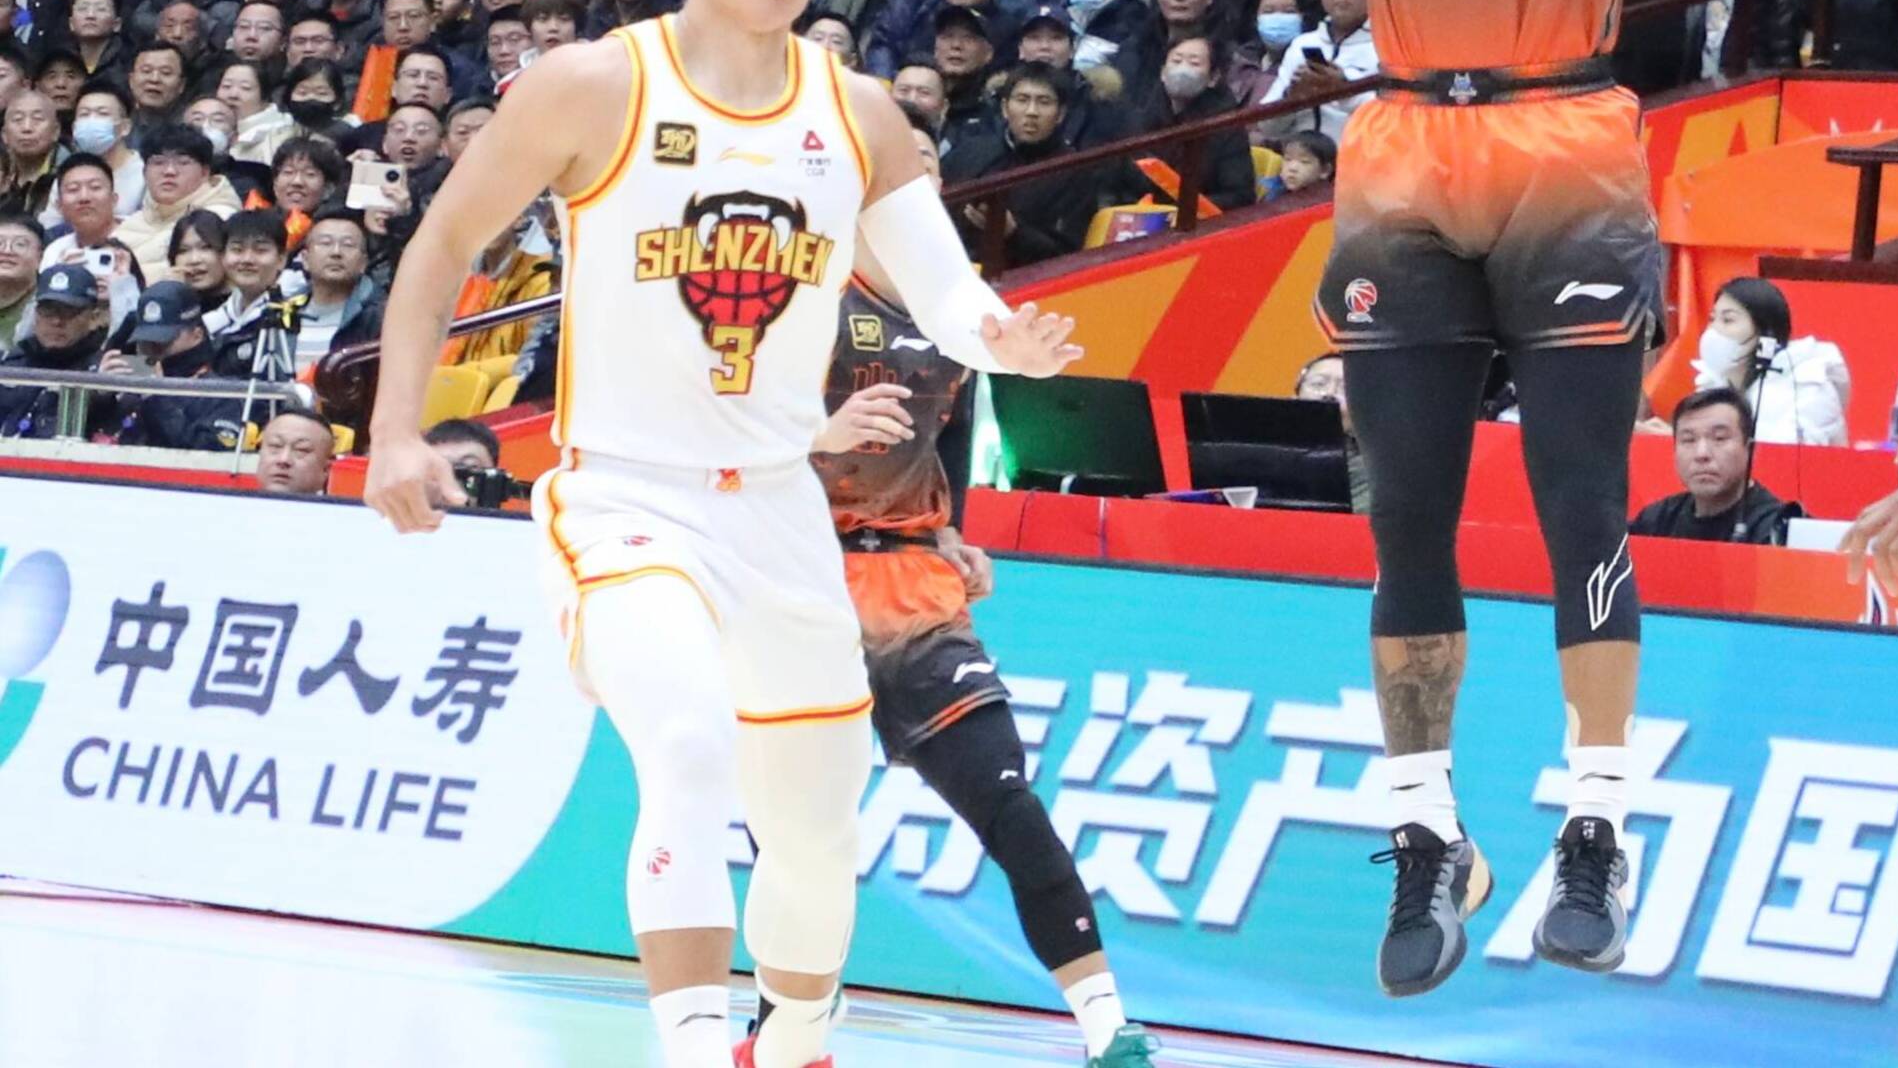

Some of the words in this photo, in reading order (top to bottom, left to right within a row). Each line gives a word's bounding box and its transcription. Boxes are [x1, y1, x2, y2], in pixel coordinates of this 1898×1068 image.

[708, 325, 755, 396] 3
[94, 580, 523, 744] 中国人寿
[62, 735, 281, 821] CHINA
[309, 765, 478, 842] LIFE
